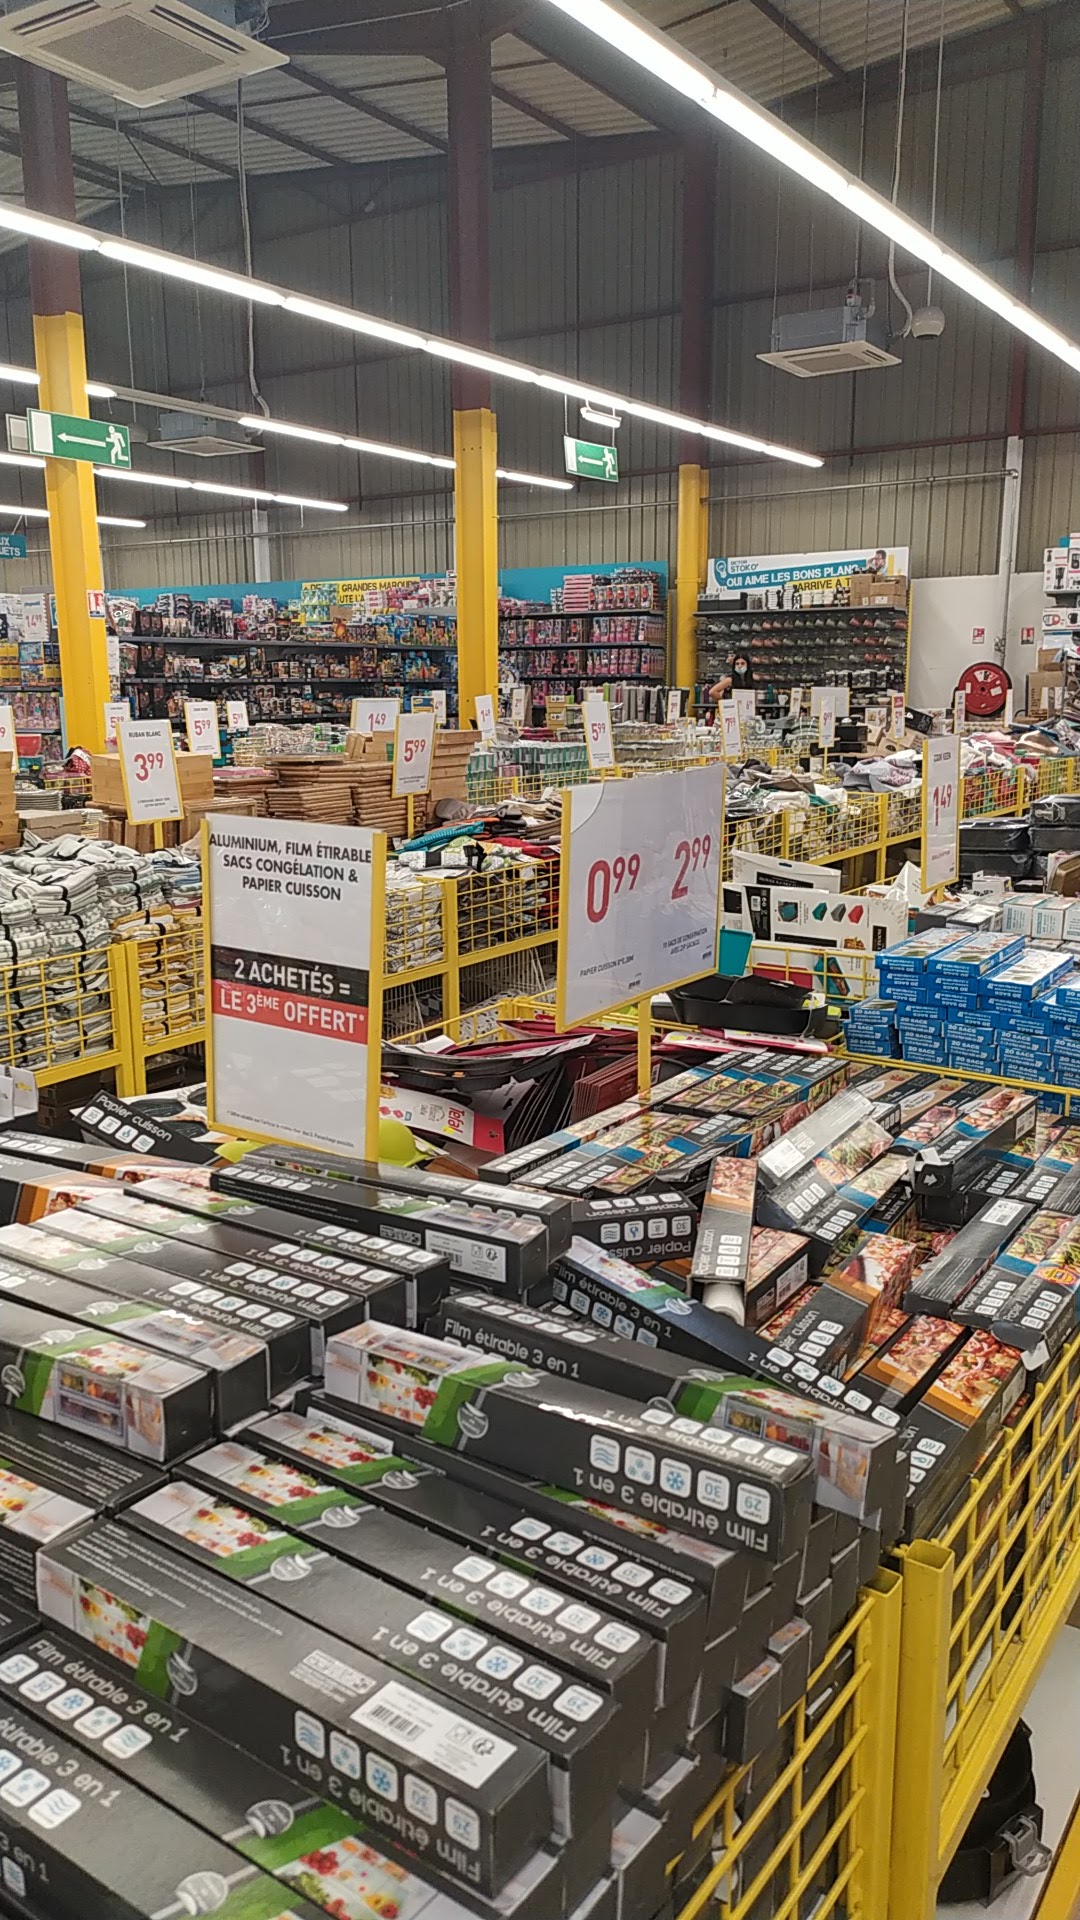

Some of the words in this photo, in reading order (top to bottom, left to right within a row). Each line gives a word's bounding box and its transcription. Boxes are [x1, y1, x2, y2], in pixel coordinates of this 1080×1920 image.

[341, 582, 378, 592] GRANDES
[726, 577, 743, 588] QUI
[744, 574, 770, 586] AIME
[771, 571, 791, 583] LES
[793, 569, 821, 581] BONS
[798, 578, 832, 591] ARRIVE
[845, 578, 851, 587] T
[193, 720, 211, 736] 599
[367, 713, 386, 730] 149
[146, 730, 162, 738] BLANC
[590, 723, 606, 742] 599
[404, 738, 427, 763] 599
[134, 752, 164, 781] 399
[933, 783, 952, 827] 149
[209, 833, 282, 856] ALUMINIUM,
[285, 841, 313, 857] FILM
[316, 841, 372, 864] ÉTIRABLE
[223, 855, 252, 870] SACS
[256, 857, 344, 881] CONGÉLATION
[348, 869, 359, 883] &
[671, 834, 712, 901] 299
[242, 876, 282, 893] PAPIER
[285, 881, 341, 901] CUISSON
[587, 853, 641, 924] 099
[234, 958, 245, 979] 2
[249, 961, 334, 995] ACHETÉS
[339, 982, 351, 995] =
[220, 989, 242, 1012] LE
[246, 991, 280, 1014] 3ÈME
[958, 1025, 976, 1033] SACS
[1012, 1033, 1031, 1041] SACS
[1015, 1050, 1034, 1058] SACS
[96, 1095, 133, 1118] Papier
[132, 1115, 173, 1142] cuisson
[448, 1106, 466, 1134] Tefal
[586, 1206, 639, 1218] cuisson
[645, 1201, 689, 1212] Papier
[647, 1241, 692, 1256] Papier
[701, 1228, 716, 1253] cuisson
[258, 1252, 277, 1261] en
[608, 1245, 643, 1259] cuiss
[211, 1272, 230, 1282] en
[342, 1277, 373, 1291] Film
[154, 1292, 175, 1301] en
[579, 1272, 627, 1312] étirable
[629, 1306, 640, 1320] 3
[644, 1314, 661, 1331] en
[664, 1325, 673, 1339] 1
[297, 1300, 328, 1315] Film
[240, 1321, 273, 1336] Film
[444, 1318, 472, 1340] Film
[475, 1328, 529, 1360] étirable
[532, 1350, 544, 1365] 3
[546, 1356, 567, 1374] en
[571, 1363, 580, 1378] 1
[573, 1468, 585, 1486] 1
[589, 1472, 616, 1494] en
[620, 1486, 636, 1504] 3
[704, 1482, 721, 1498] 30
[641, 1493, 719, 1537] étirable
[481, 1524, 496, 1537] 1
[496, 1531, 525, 1548] en
[726, 1524, 769, 1552] Film
[524, 1546, 544, 1560] 3
[420, 1566, 437, 1580] 1
[545, 1552, 623, 1597] étirable
[437, 1574, 467, 1595] en
[465, 1590, 485, 1605] 3
[627, 1590, 671, 1618] Film
[487, 1597, 568, 1646] étirable
[371, 1625, 389, 1641] 1
[389, 1633, 419, 1656] en
[570, 1639, 617, 1671] Film
[418, 1651, 439, 1670] 3
[28, 1638, 66, 1666] Film
[63, 1660, 129, 1705] étirable
[126, 1700, 148, 1715] 3
[143, 1712, 173, 1733] en
[169, 1726, 189, 1744] 1
[441, 1659, 525, 1714] étirable
[527, 1704, 578, 1743] Film
[280, 1745, 291, 1766] 1
[297, 1753, 322, 1781] en
[56, 1759, 79, 1777] 3
[73, 1772, 104, 1799] en
[99, 1789, 121, 1809] 1
[328, 1775, 343, 1798] 3
[349, 1785, 429, 1849] étirable
[13, 1846, 36, 1871] en
[38, 1862, 50, 1882] 1
[436, 1838, 481, 1882] Film
